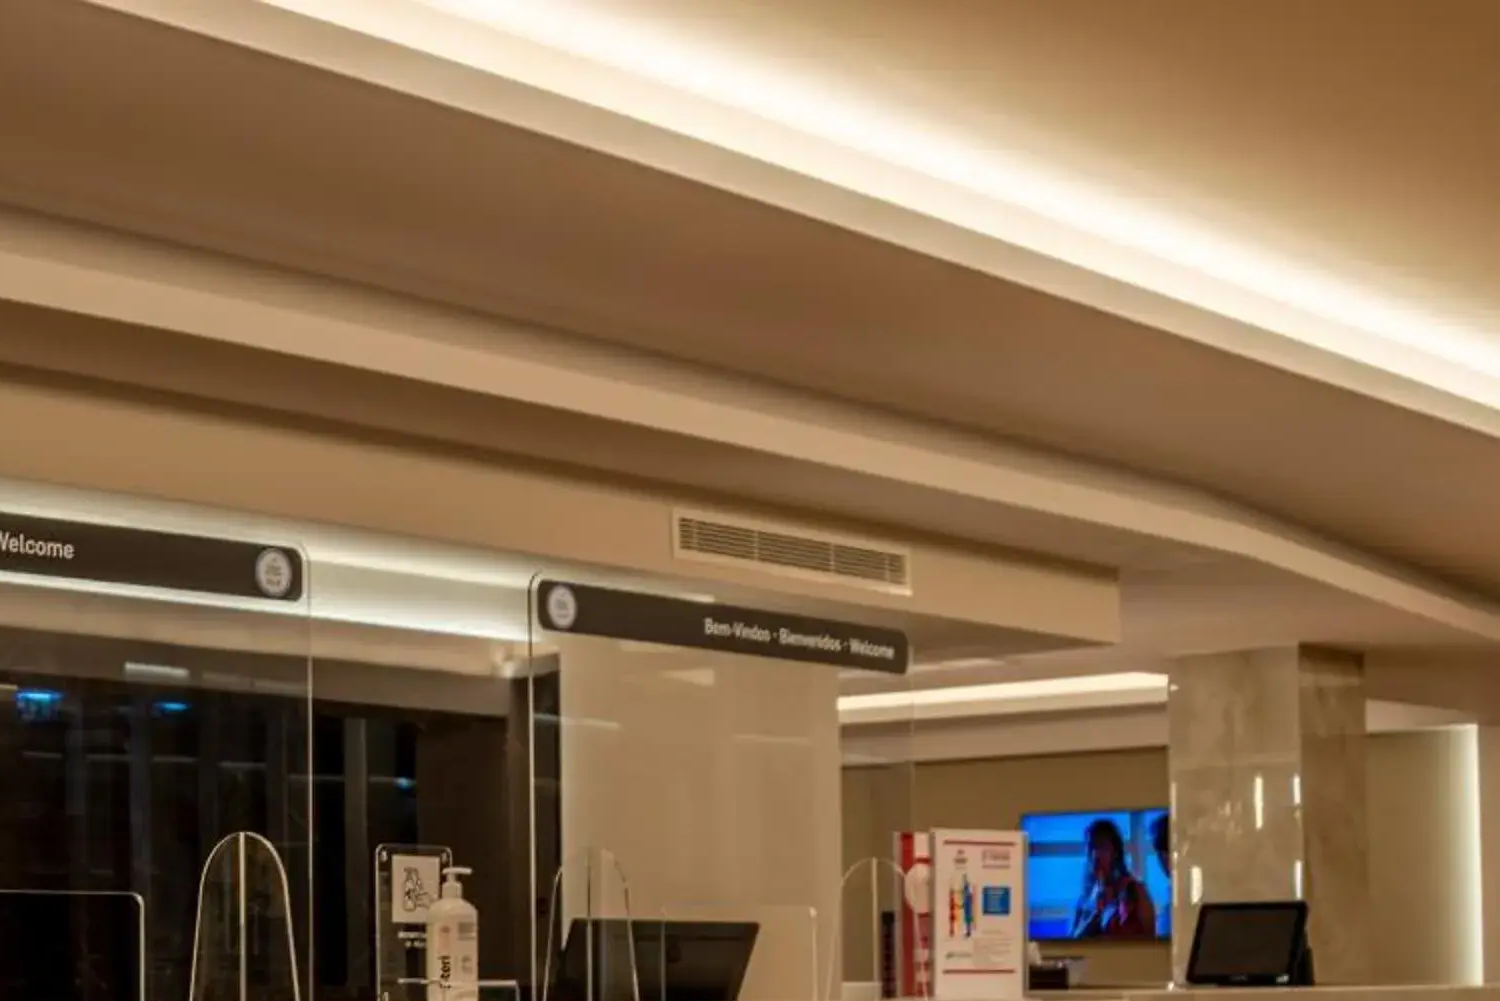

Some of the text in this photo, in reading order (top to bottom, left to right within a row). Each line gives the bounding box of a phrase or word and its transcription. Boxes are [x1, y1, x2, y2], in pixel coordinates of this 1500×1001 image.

[703, 617, 895, 660] Bem-Vindos Bienvenidos Welcome
